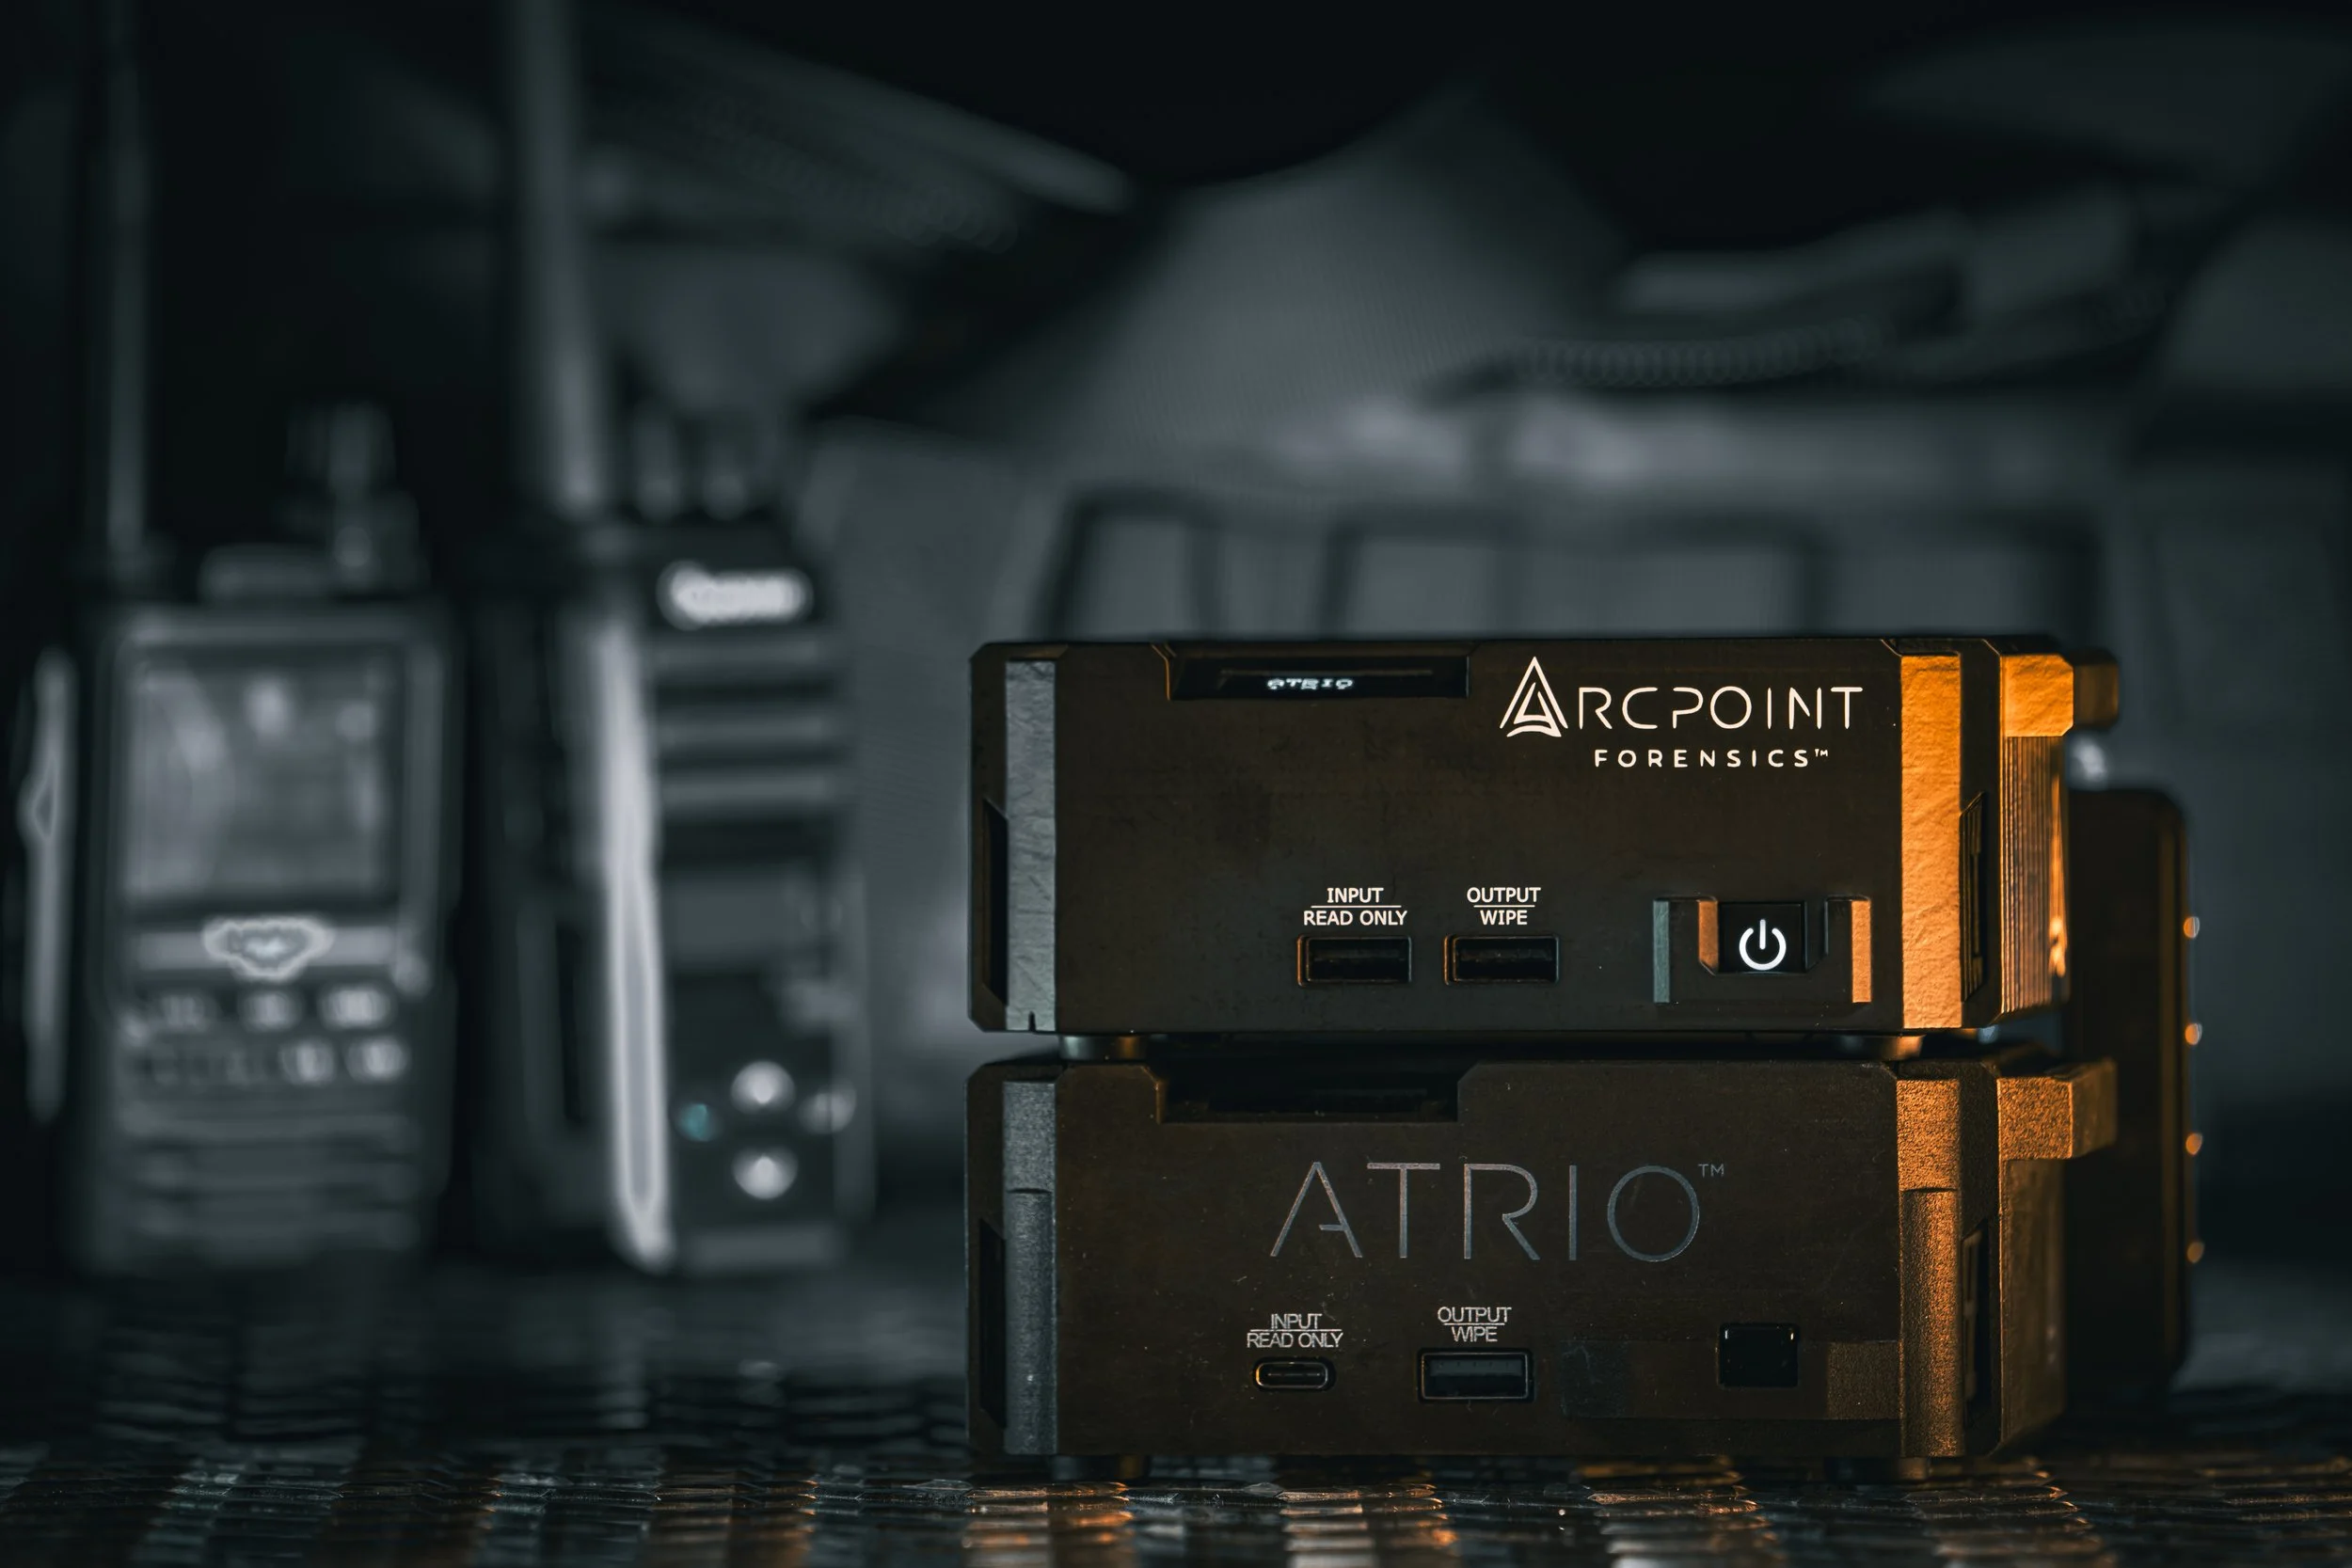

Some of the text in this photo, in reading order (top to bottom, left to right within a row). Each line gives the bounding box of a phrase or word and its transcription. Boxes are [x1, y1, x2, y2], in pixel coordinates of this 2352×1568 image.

[1499, 656, 1864, 737] ARCPOINT
[1327, 887, 1385, 903] INPUT
[1466, 886, 1542, 903] OUTPUT
[1303, 910, 1408, 927] READ ONLY
[1479, 910, 1528, 926] WIPE
[1270, 1312, 1323, 1330] INPUT
[1437, 1306, 1513, 1323] OUTPUT
[1247, 1331, 1344, 1348] READ ONLY
[1451, 1325, 1498, 1343] WIPE
